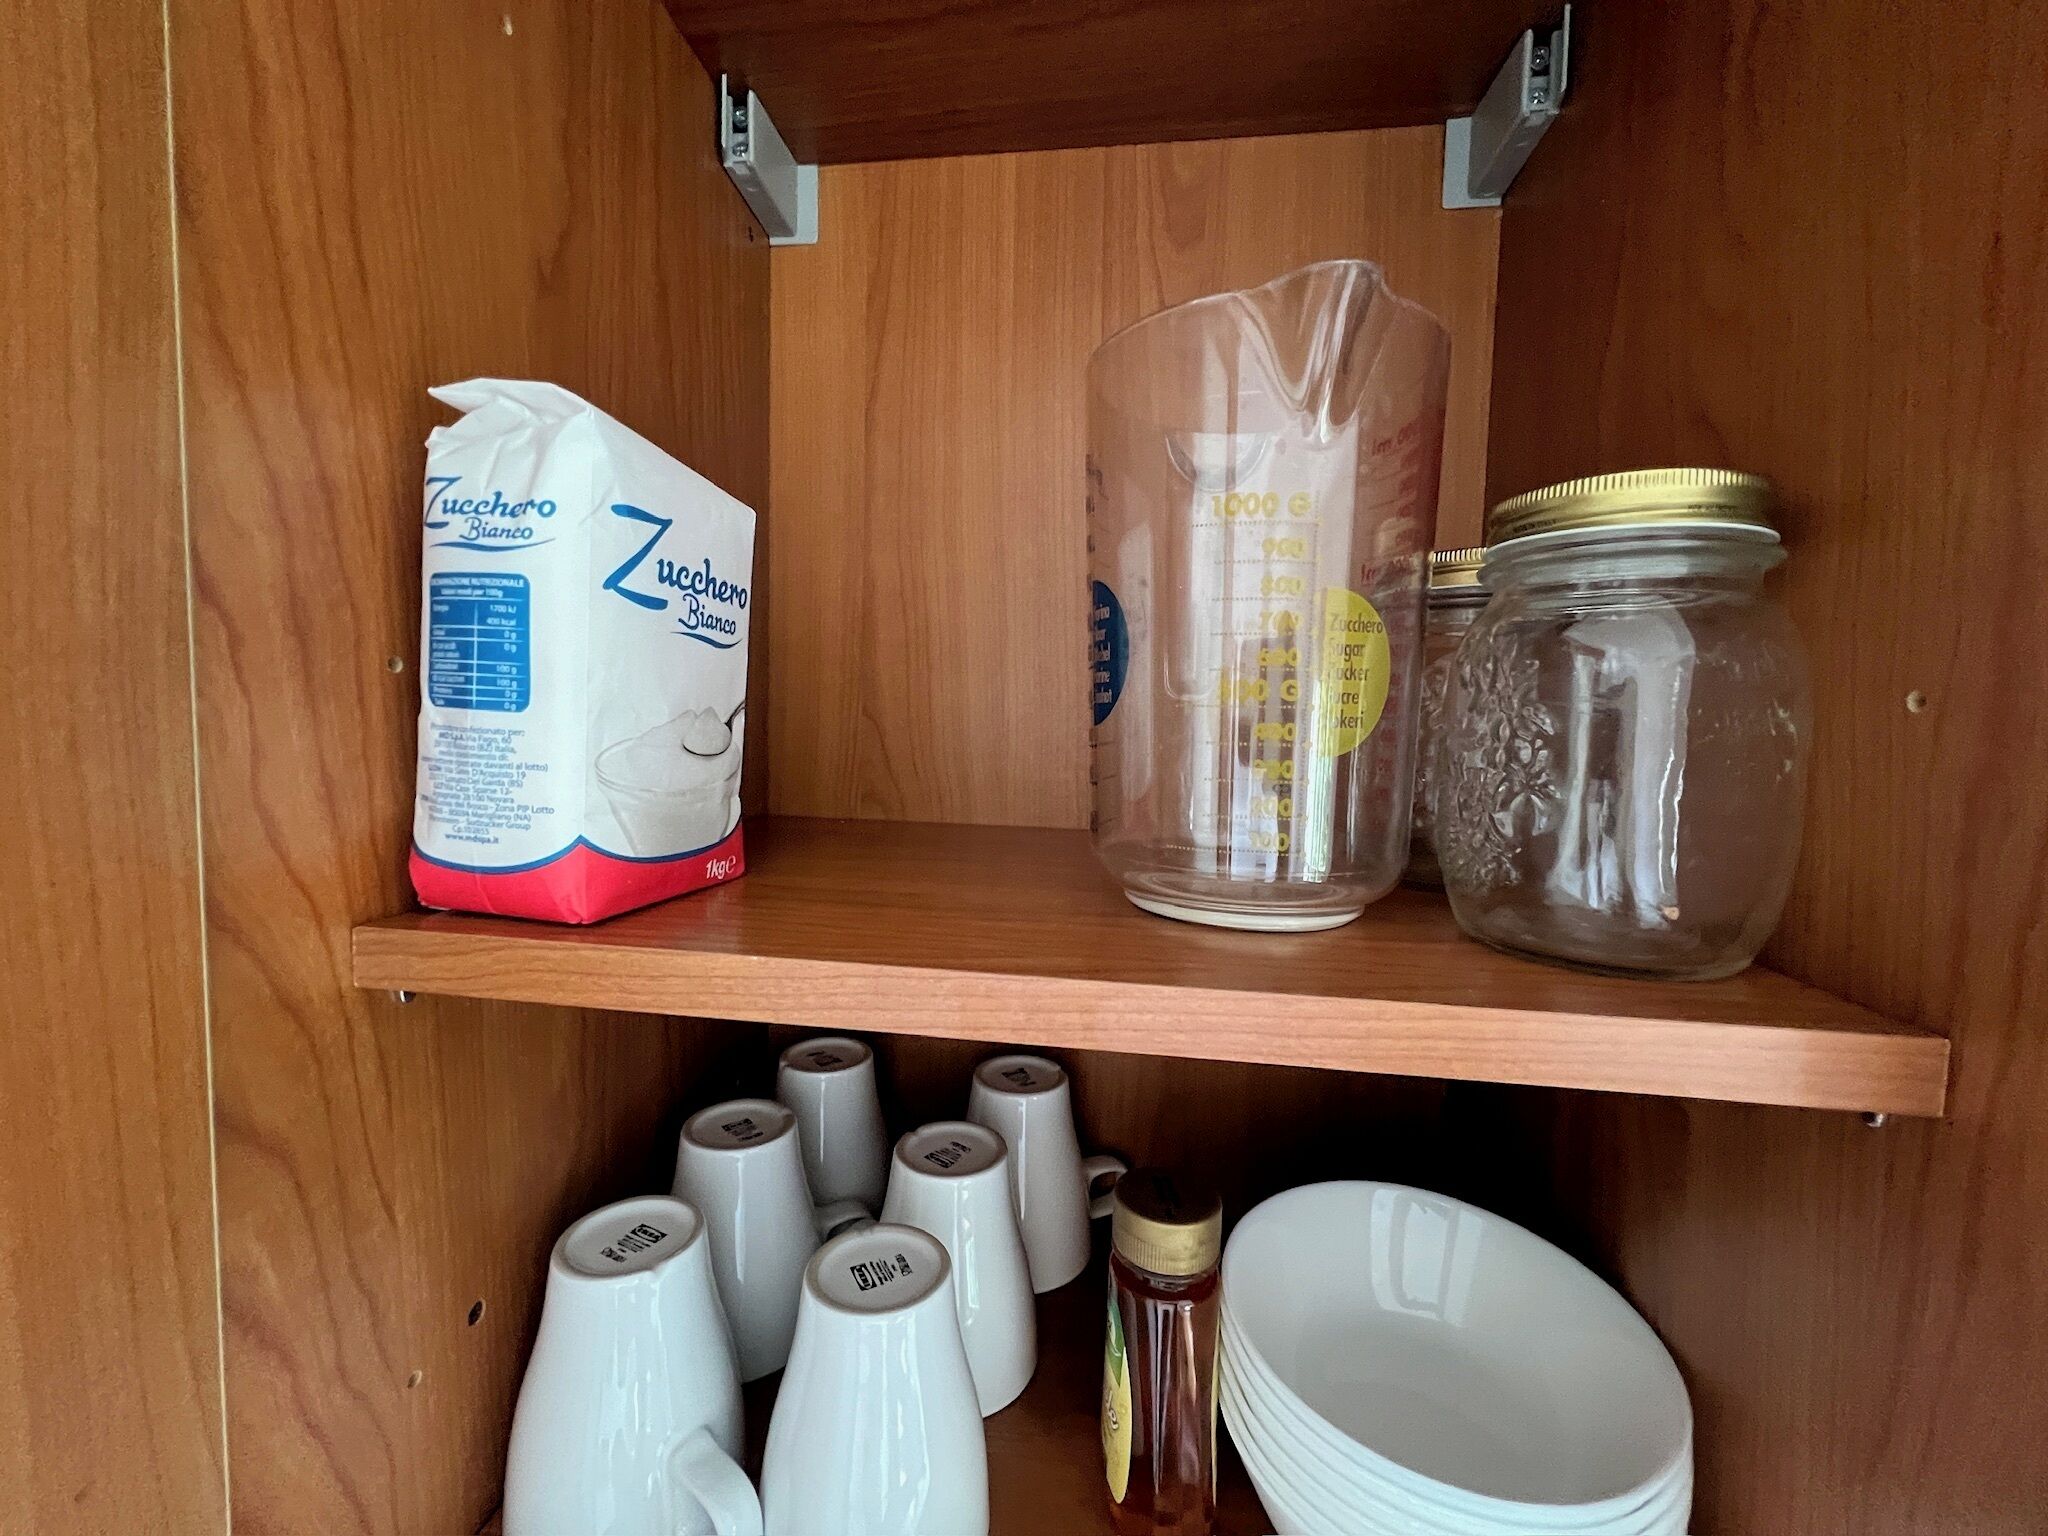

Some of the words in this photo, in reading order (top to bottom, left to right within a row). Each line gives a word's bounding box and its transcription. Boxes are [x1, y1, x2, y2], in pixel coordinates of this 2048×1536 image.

[423, 476, 557, 530] Zucchero
[1212, 492, 1280, 518] 1000
[459, 516, 534, 542] Bianco
[602, 503, 748, 611] Zucchero
[678, 593, 737, 635] Bianco
[1330, 613, 1383, 634] Zucchero
[1330, 638, 1365, 662] ugar
[1329, 661, 1369, 682] ucker
[1331, 709, 1364, 729] okeri
[483, 761, 514, 770] davanti
[516, 762, 523, 770] al
[525, 762, 549, 772] lotto)
[517, 771, 526, 779] 19
[495, 804, 515, 812] Zona
[532, 805, 555, 815] Lotto
[505, 821, 531, 831] Group
